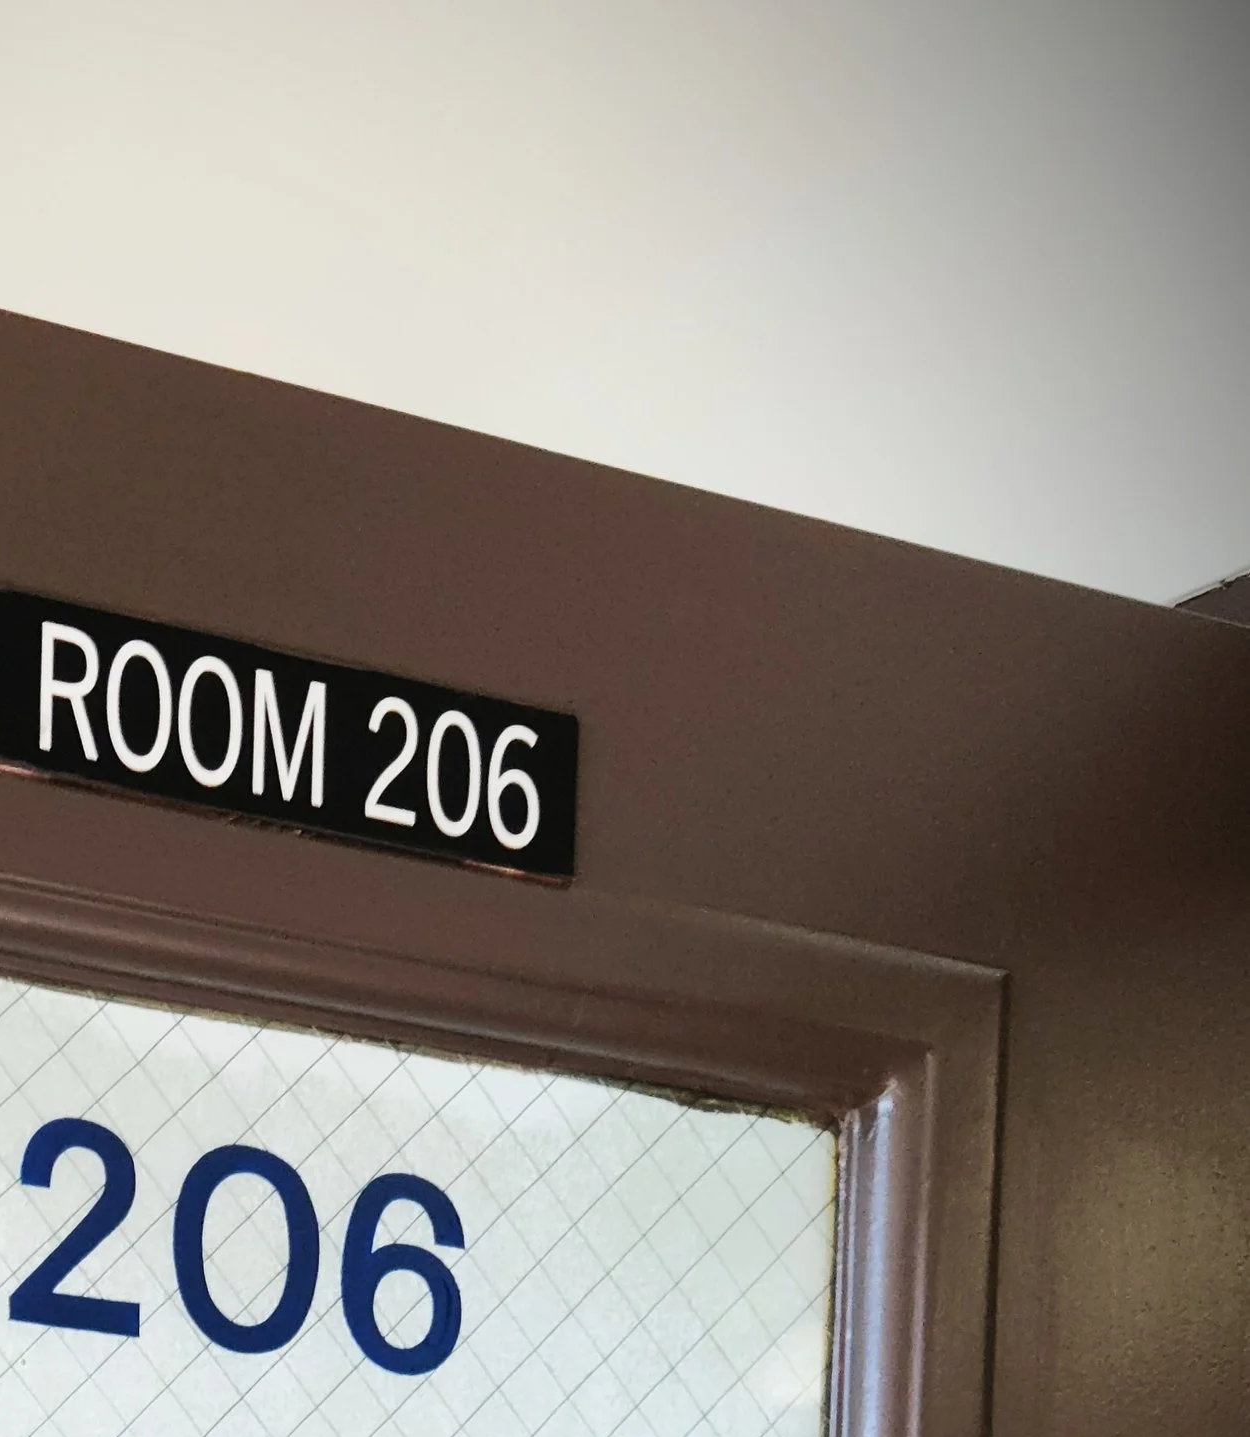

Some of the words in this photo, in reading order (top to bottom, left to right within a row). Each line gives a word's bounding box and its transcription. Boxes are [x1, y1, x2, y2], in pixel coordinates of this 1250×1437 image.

[39, 620, 327, 808] ROOM
[364, 696, 540, 850] 206
[9, 1117, 466, 1376] 206
